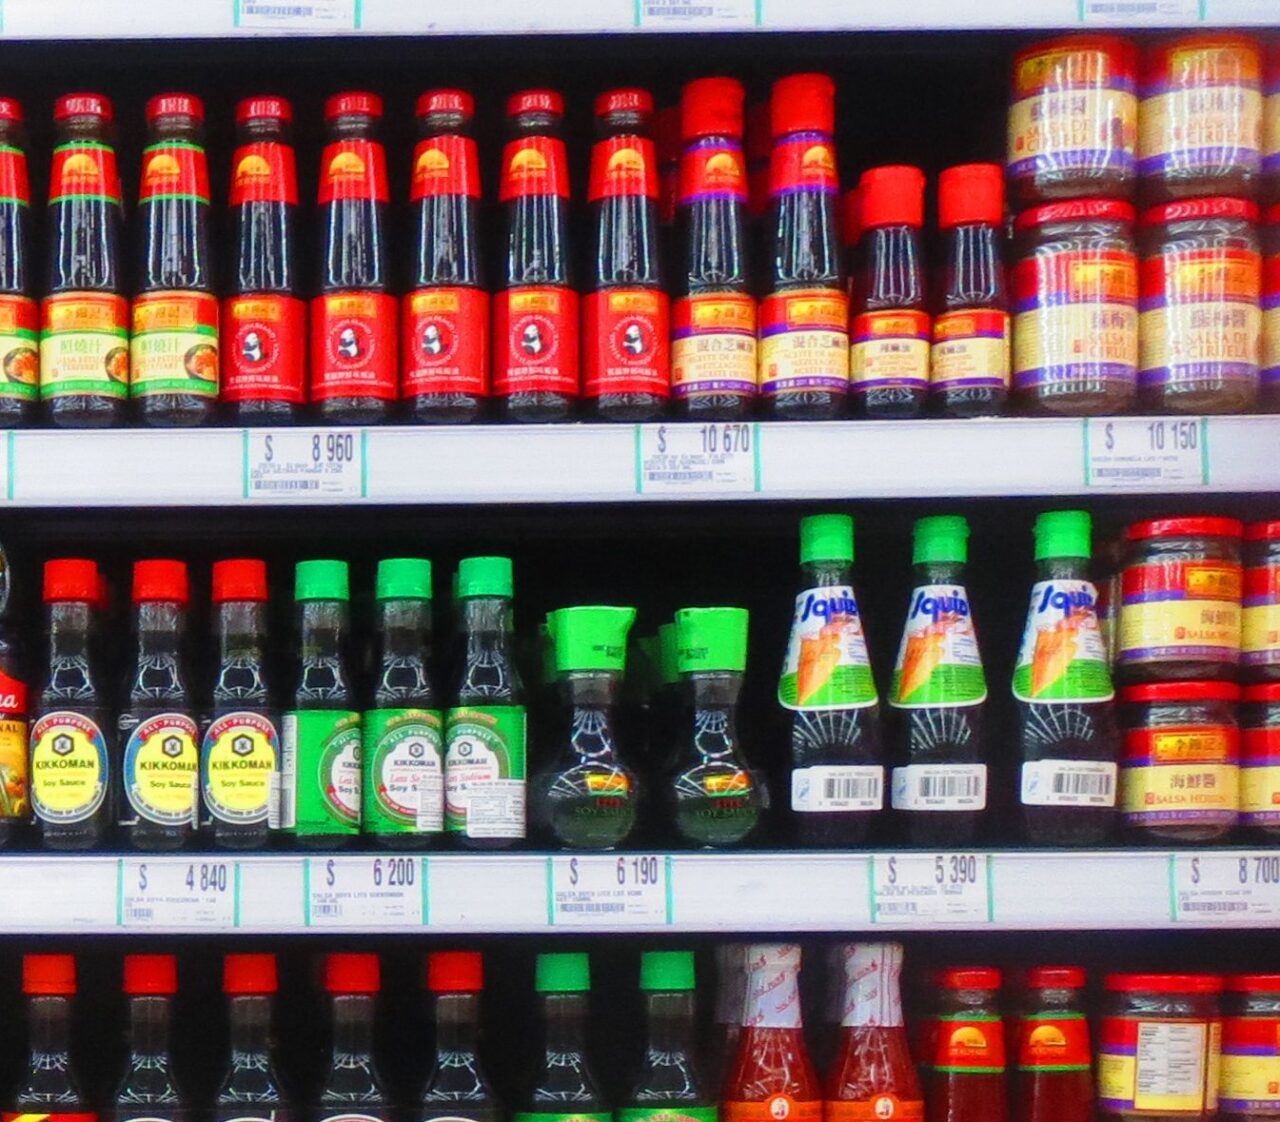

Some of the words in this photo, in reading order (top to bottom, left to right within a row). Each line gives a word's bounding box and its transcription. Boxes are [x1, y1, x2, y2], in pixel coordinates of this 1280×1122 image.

[36, 759, 95, 770] KIKKOMAN
[212, 759, 271, 771] KIKKOMAN
[43, 779, 57, 789] Soy
[59, 778, 86, 786] Sauce
